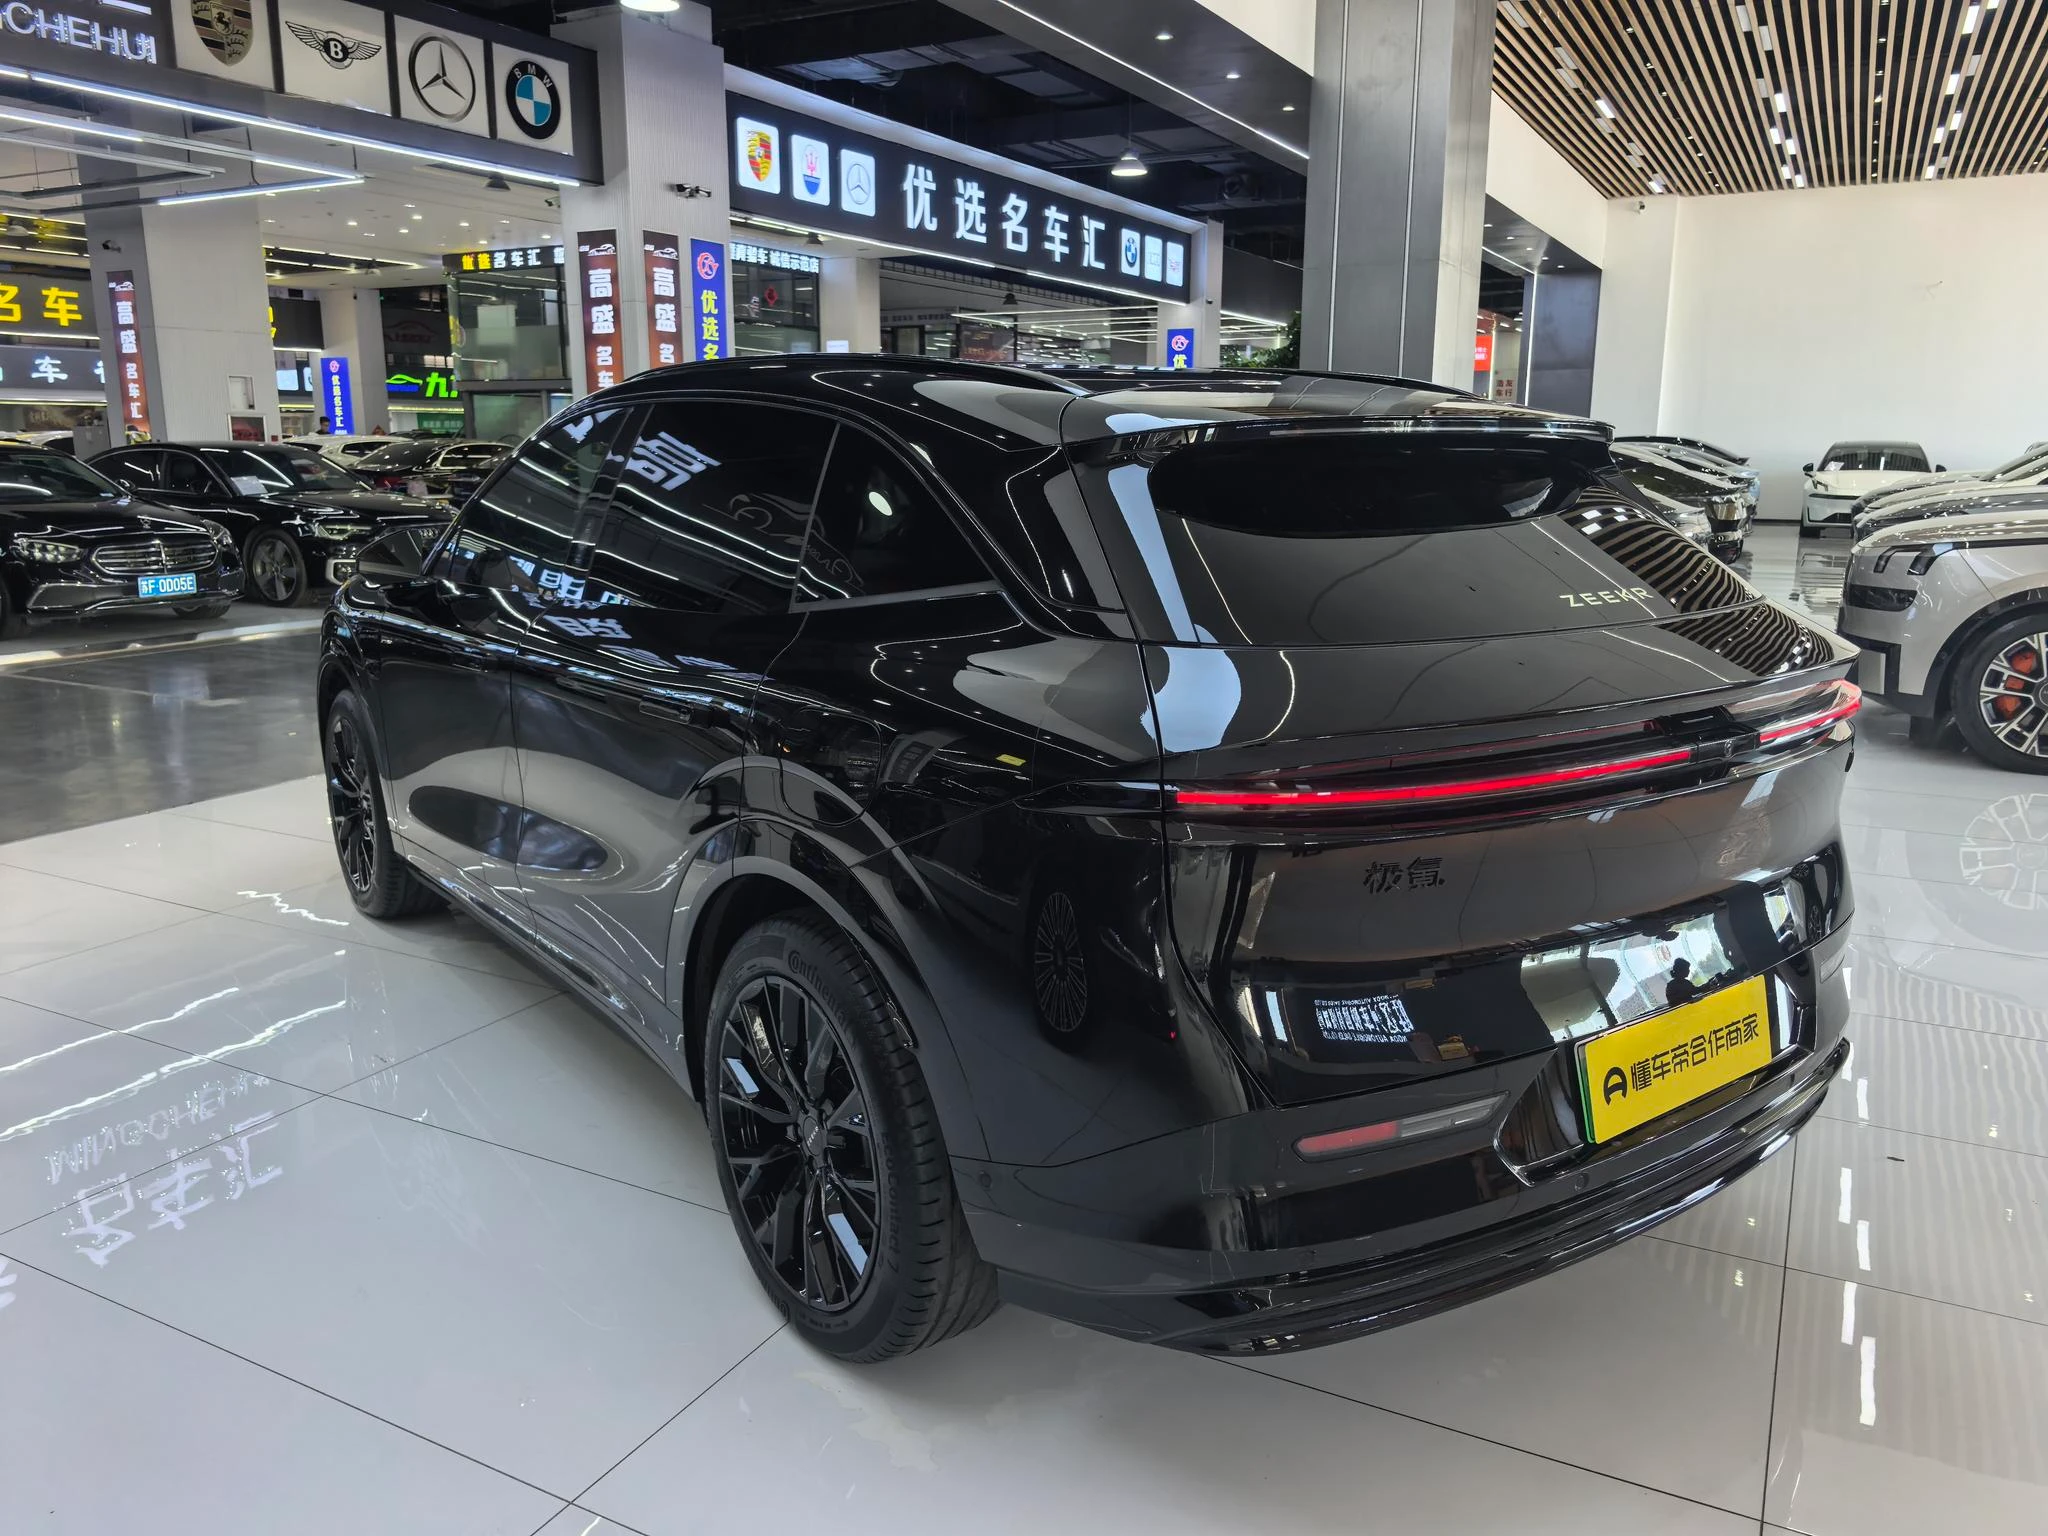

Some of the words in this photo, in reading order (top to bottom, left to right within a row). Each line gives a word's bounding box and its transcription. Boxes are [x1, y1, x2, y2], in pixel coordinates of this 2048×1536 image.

[0, 2, 157, 64] CHEHUI
[513, 63, 553, 88] BMW
[903, 163, 1106, 270] 优选名车汇
[653, 267, 676, 363] 高盛名
[1560, 587, 1654, 608] ZEEKR
[1630, 1013, 1759, 1092] 懂车帝合作商家
